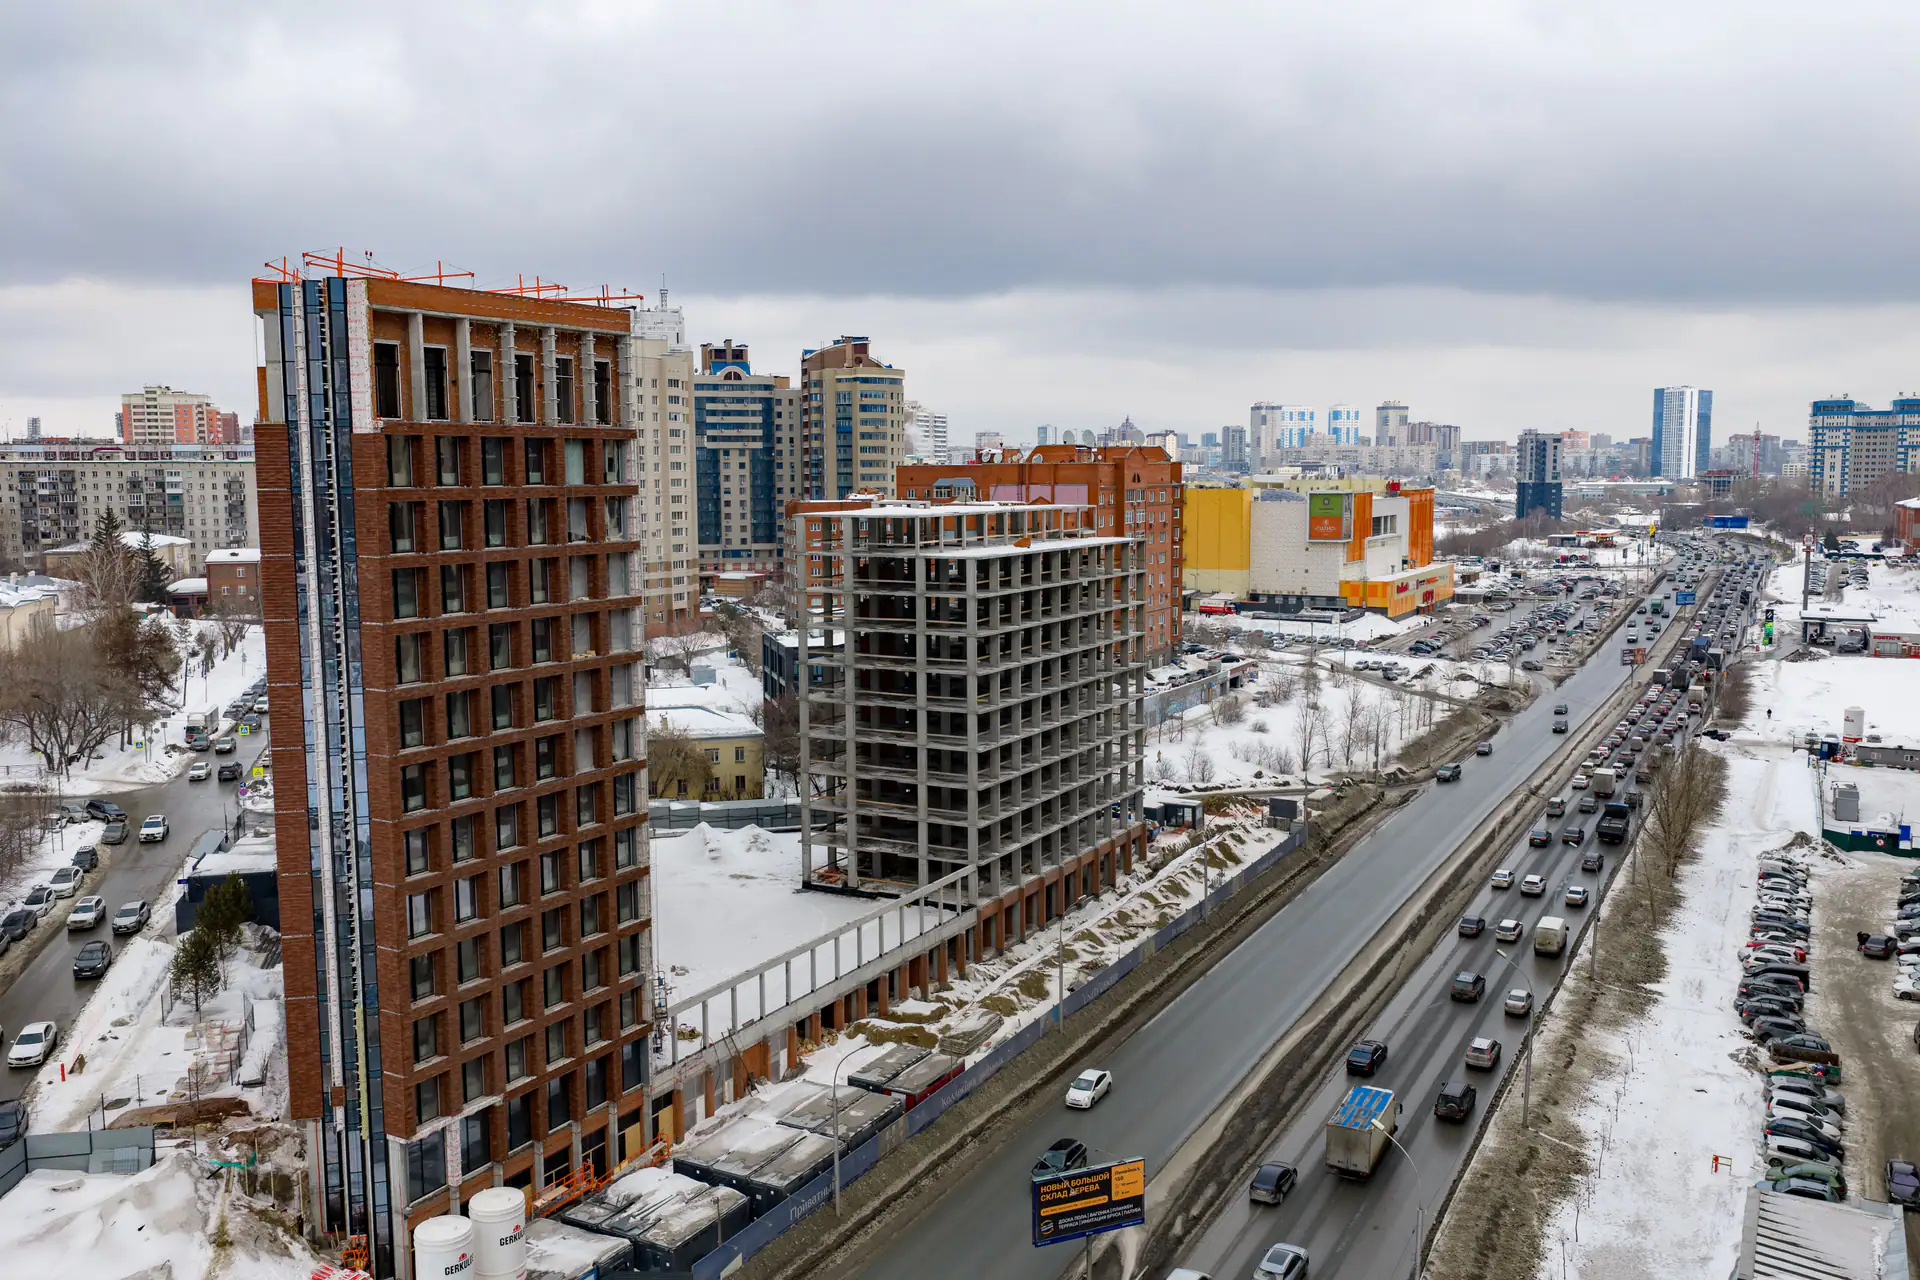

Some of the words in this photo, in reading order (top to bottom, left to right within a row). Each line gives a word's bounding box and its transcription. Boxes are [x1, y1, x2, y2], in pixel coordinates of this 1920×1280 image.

[1040, 1180, 1069, 1193] НОВЫЙ
[1071, 1172, 1110, 1187] БОЛЬШОЙ
[1040, 1188, 1068, 1202] СКЛАД
